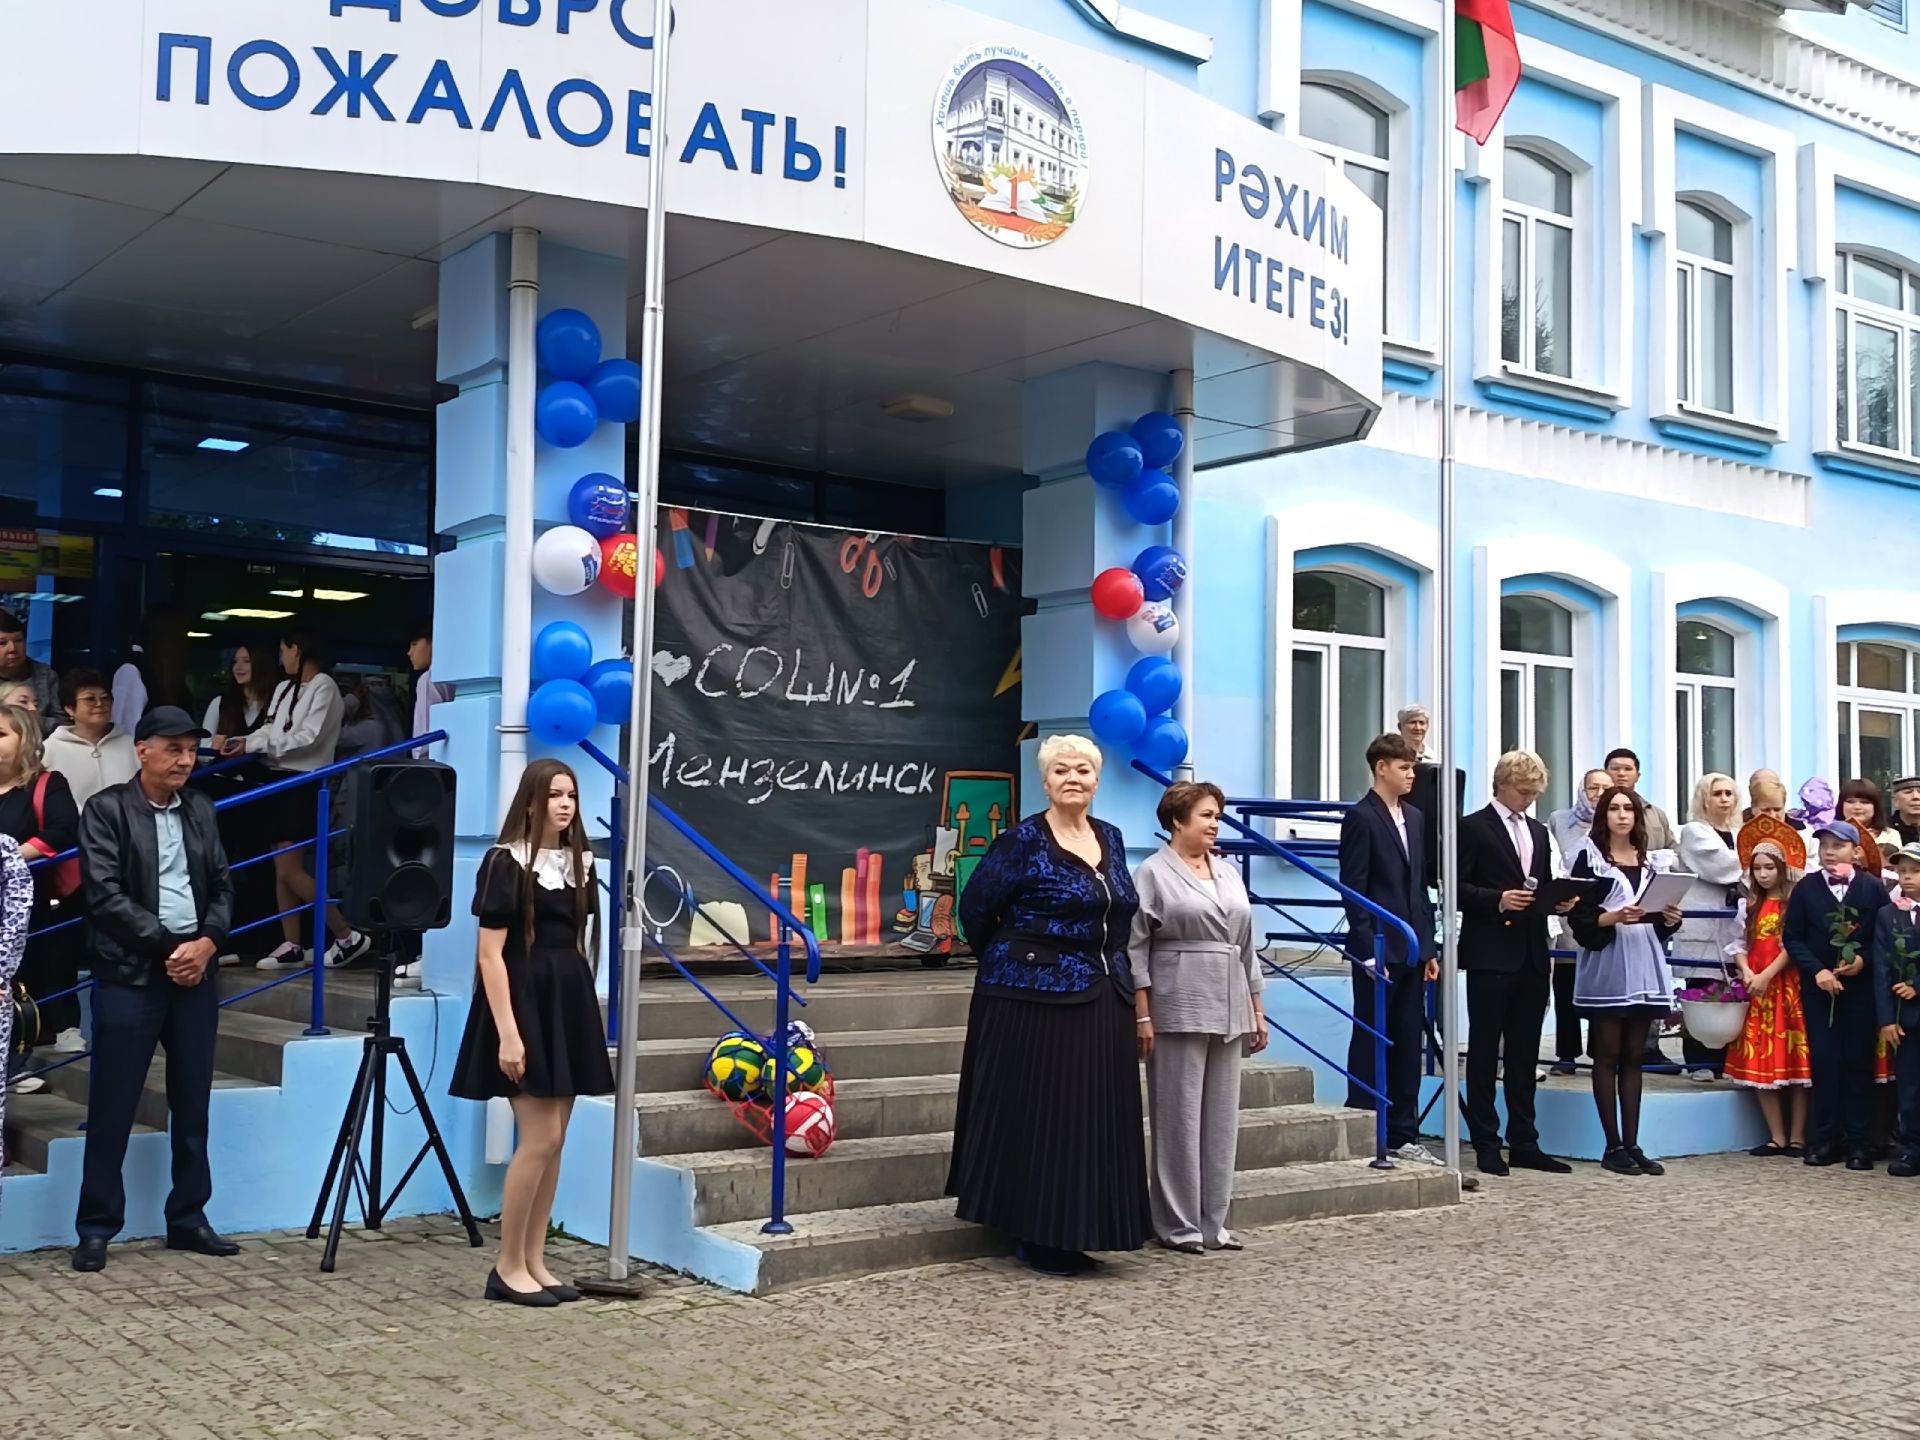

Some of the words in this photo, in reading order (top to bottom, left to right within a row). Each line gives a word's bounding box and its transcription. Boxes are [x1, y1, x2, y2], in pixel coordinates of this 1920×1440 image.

[157, 33, 846, 188] ПОЖАЛОВАТЬ!
[937, 79, 955, 129] Хочешь
[953, 53, 982, 76] быть
[984, 46, 1029, 60] лучшим
[1215, 147, 1348, 265] РӘХИМ
[1214, 235, 1348, 346] ИТЕГЕЗ!
